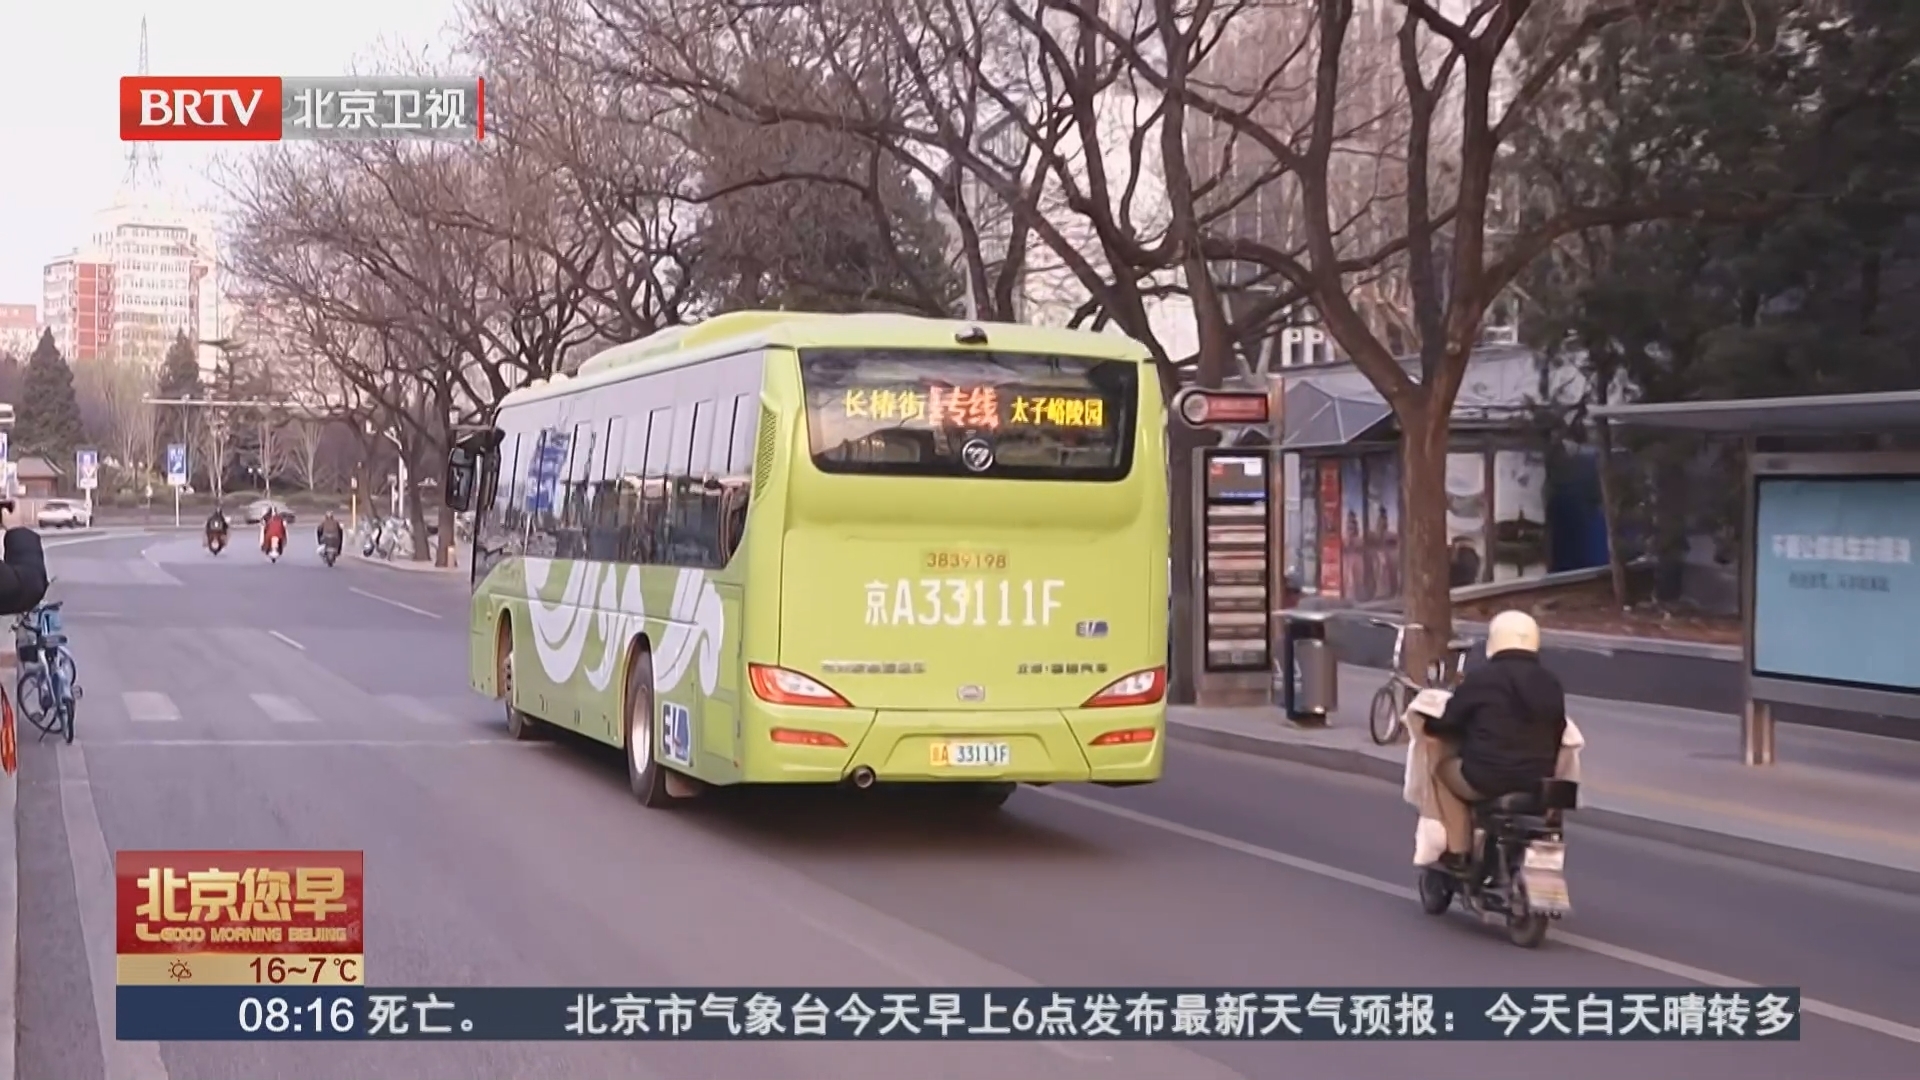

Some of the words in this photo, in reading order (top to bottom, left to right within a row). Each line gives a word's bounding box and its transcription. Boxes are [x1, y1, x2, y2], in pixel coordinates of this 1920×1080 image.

[845, 388, 925, 420] 长椿街
[1010, 395, 1104, 427] 太子峪陵园
[927, 553, 1007, 569] 3839198
[864, 578, 1065, 627] 京A33111F
[932, 745, 1008, 763] A33111F
